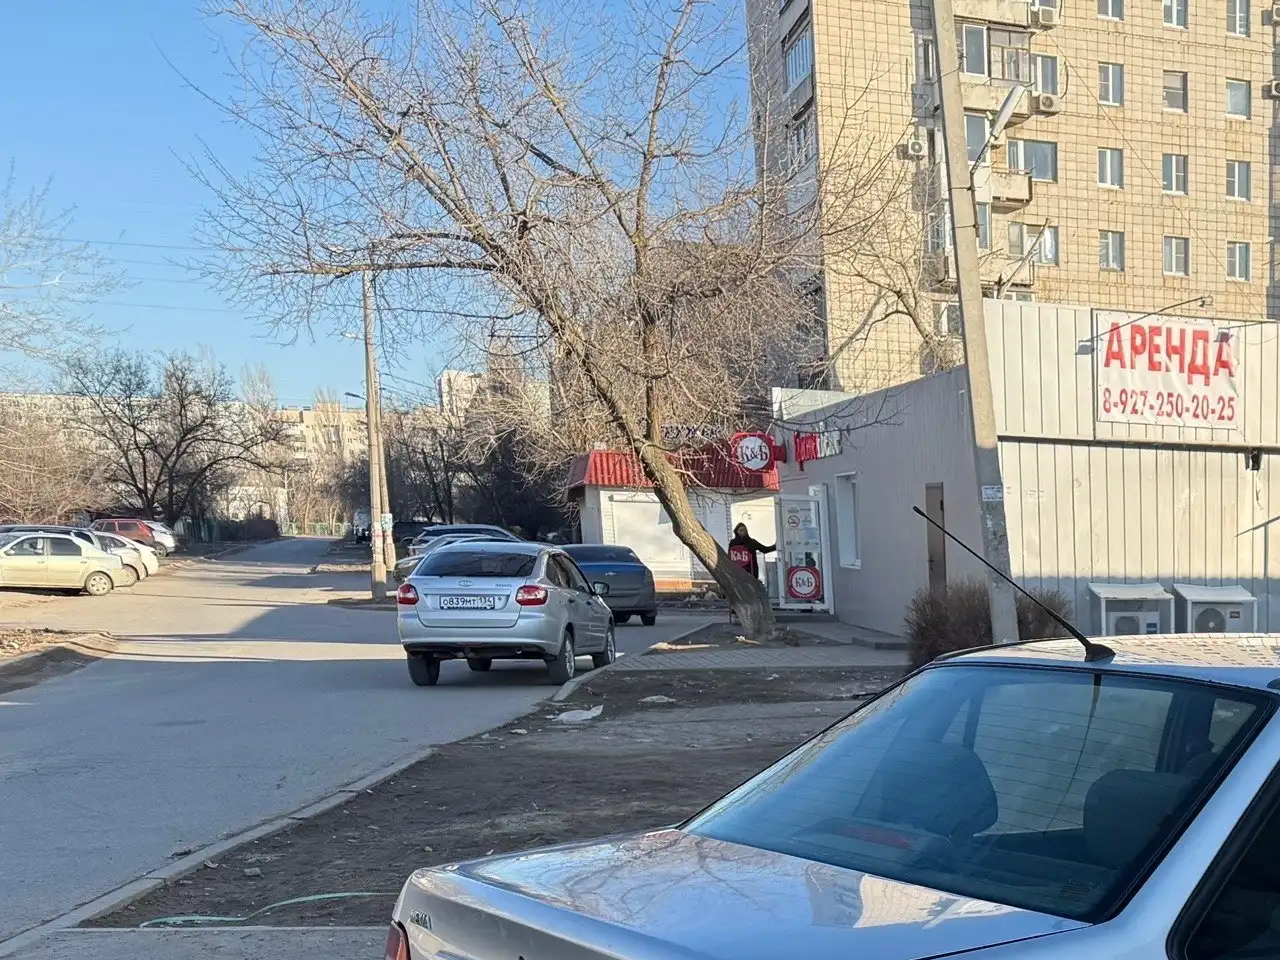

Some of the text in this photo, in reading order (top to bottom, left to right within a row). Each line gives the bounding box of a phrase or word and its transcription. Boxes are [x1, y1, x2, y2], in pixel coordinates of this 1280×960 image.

[1104, 322, 1235, 386] АРЕНДА
[1103, 387, 1235, 421] 8-927-250-20-25
[739, 444, 769, 465] К&Б
[730, 550, 748, 561] К&Б
[795, 576, 812, 588] К&Б
